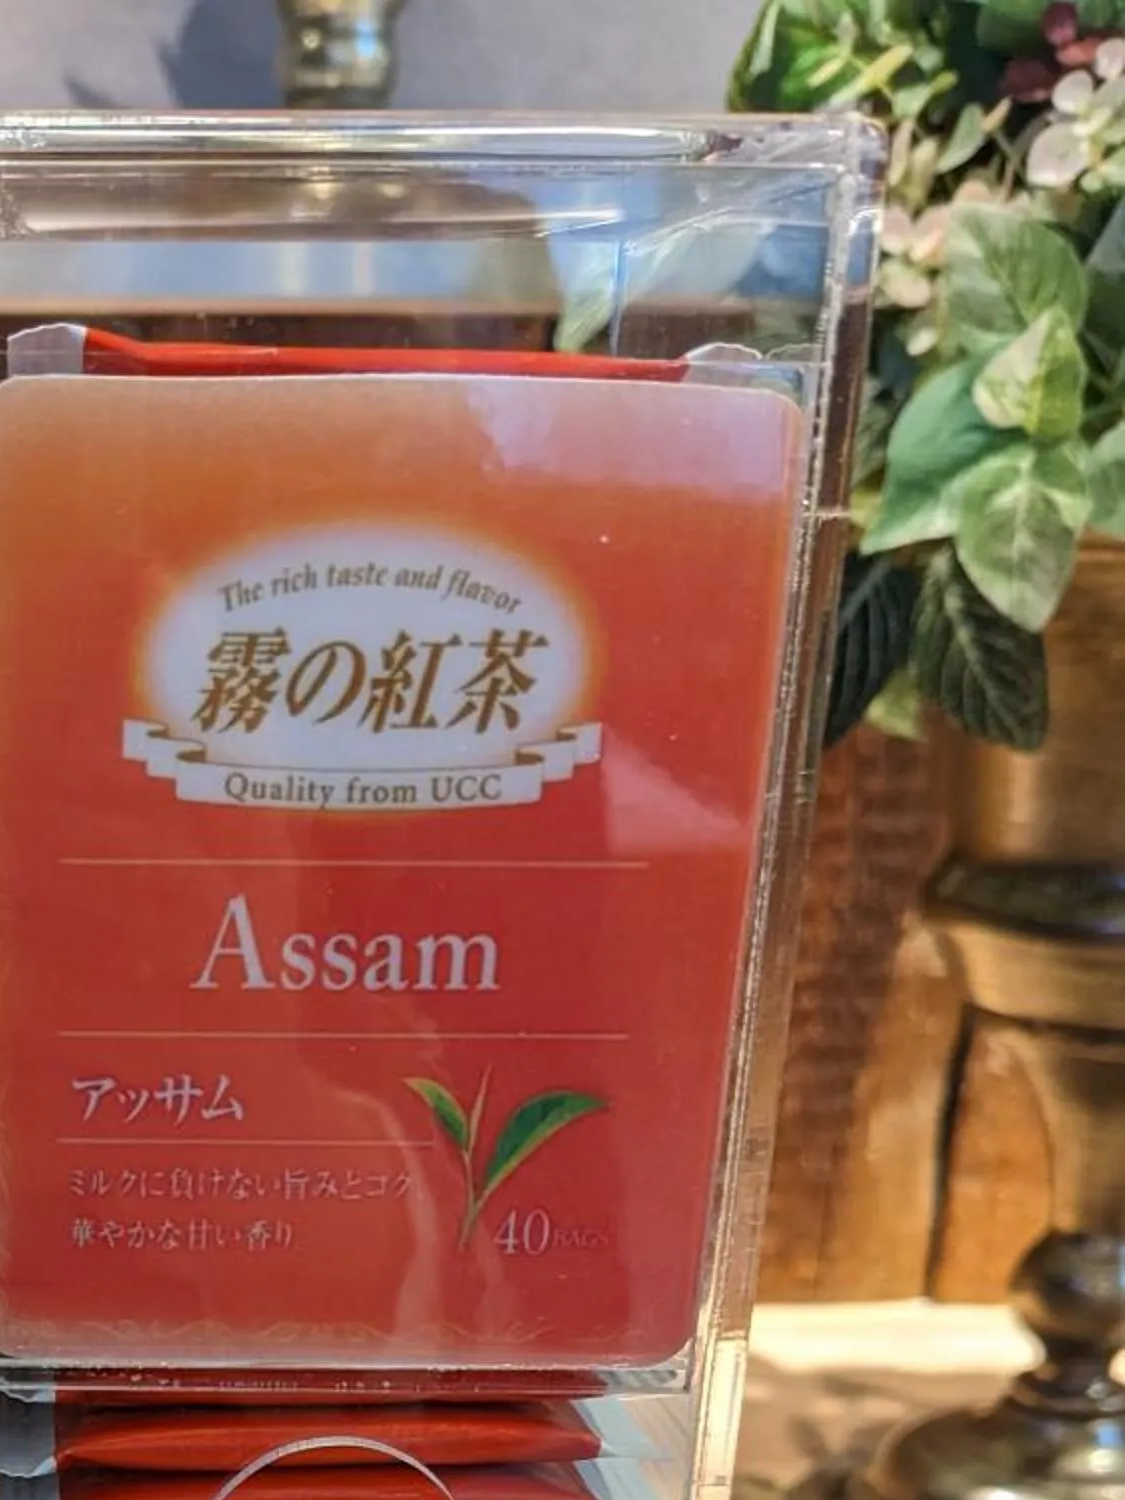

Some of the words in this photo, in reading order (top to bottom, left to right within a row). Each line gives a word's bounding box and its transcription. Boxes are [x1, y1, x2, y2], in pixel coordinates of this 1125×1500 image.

[218, 583, 264, 613] The
[271, 563, 318, 594] rich
[327, 562, 388, 589] taste
[394, 564, 441, 591] and
[442, 565, 523, 616] flavor
[190, 626, 551, 735] 霧の紅茶
[224, 772, 334, 811] Quality
[347, 774, 418, 804] from
[430, 774, 502, 802] UCC
[190, 893, 501, 992] Assam
[71, 1074, 246, 1123] アッサム
[493, 1207, 550, 1256] 40
